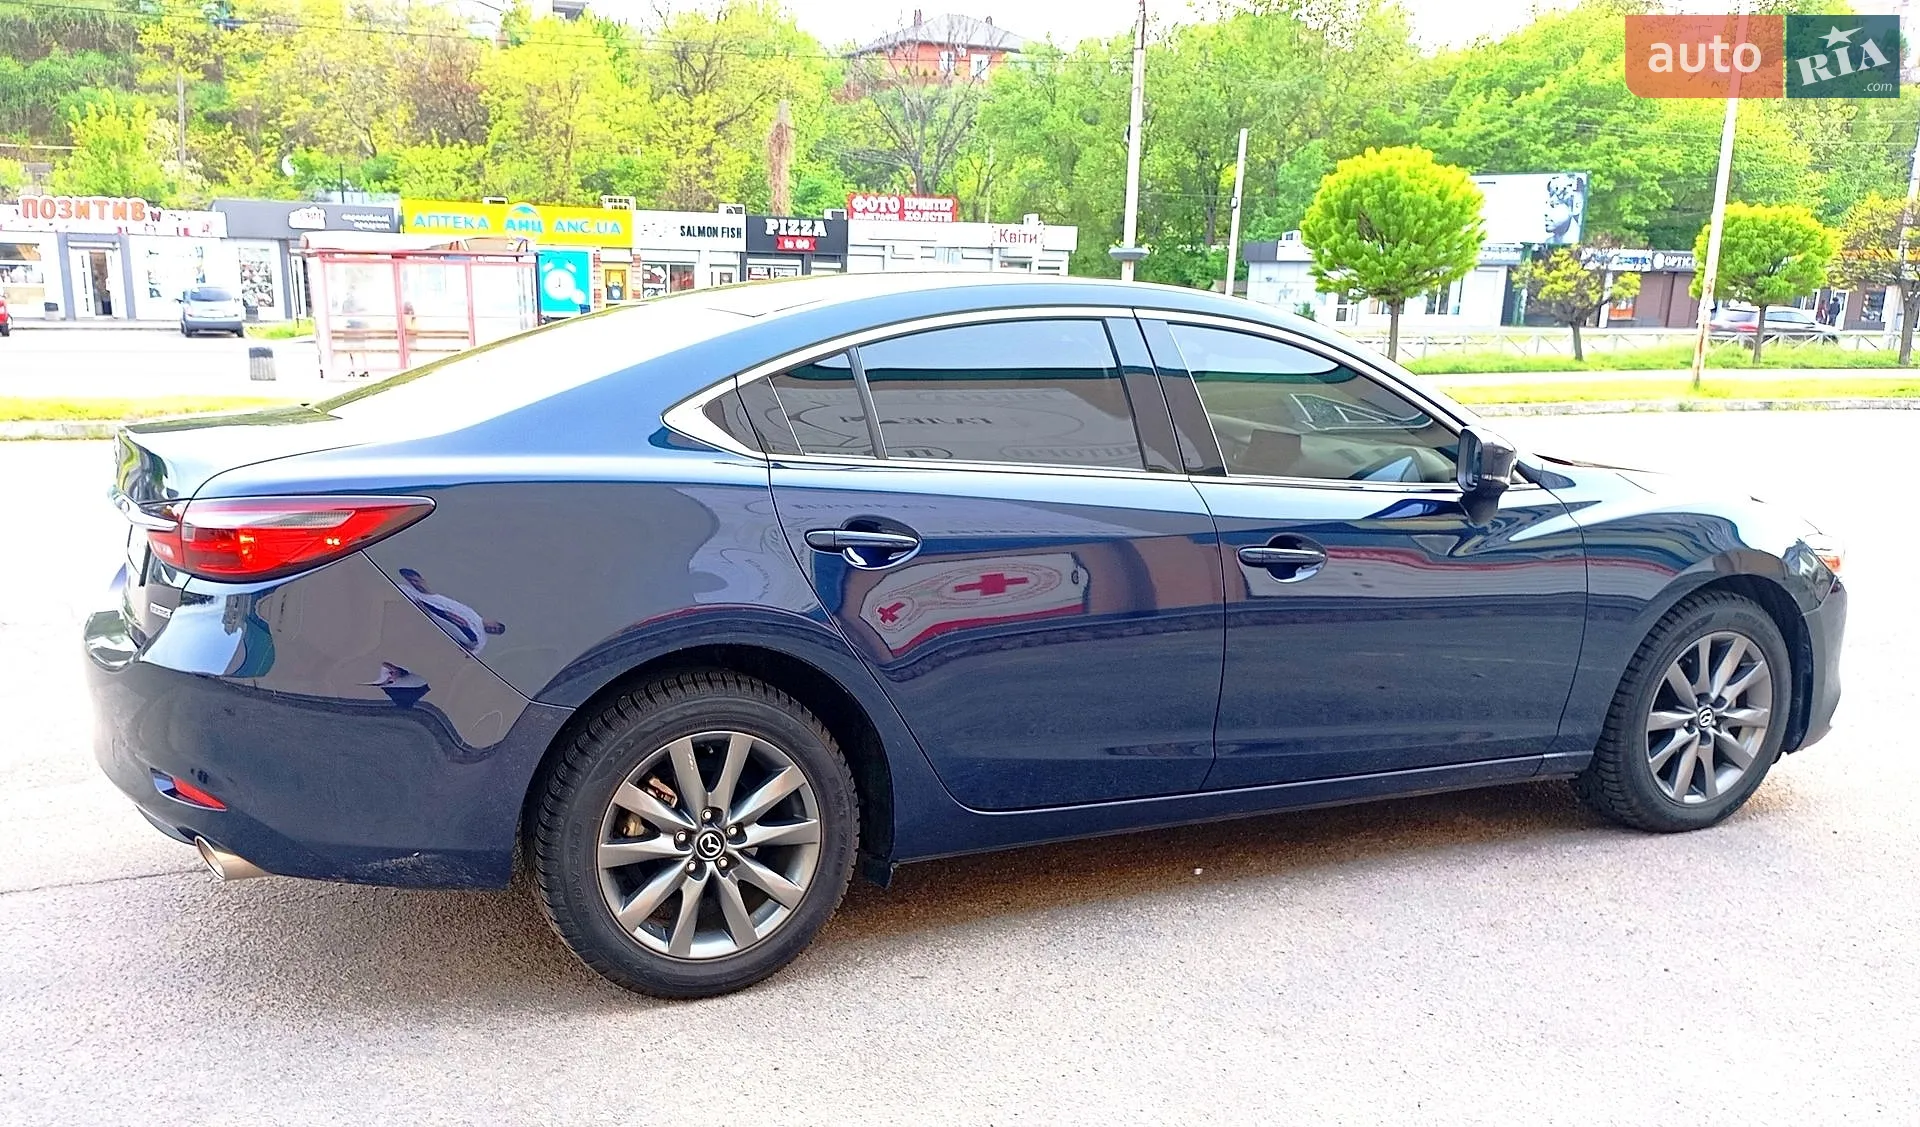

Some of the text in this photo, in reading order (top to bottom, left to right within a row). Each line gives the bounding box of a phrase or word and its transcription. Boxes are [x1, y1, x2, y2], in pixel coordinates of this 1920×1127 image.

[22, 198, 147, 221] ПОЗИТИВ
[852, 195, 900, 213] ФОТО
[414, 214, 490, 229] АПТЕКА
[505, 218, 543, 234] АНЦ
[680, 225, 719, 238] SALMON
[721, 226, 742, 239] FISH
[765, 218, 828, 237] PIZZA
[999, 228, 1038, 244] Квіти
